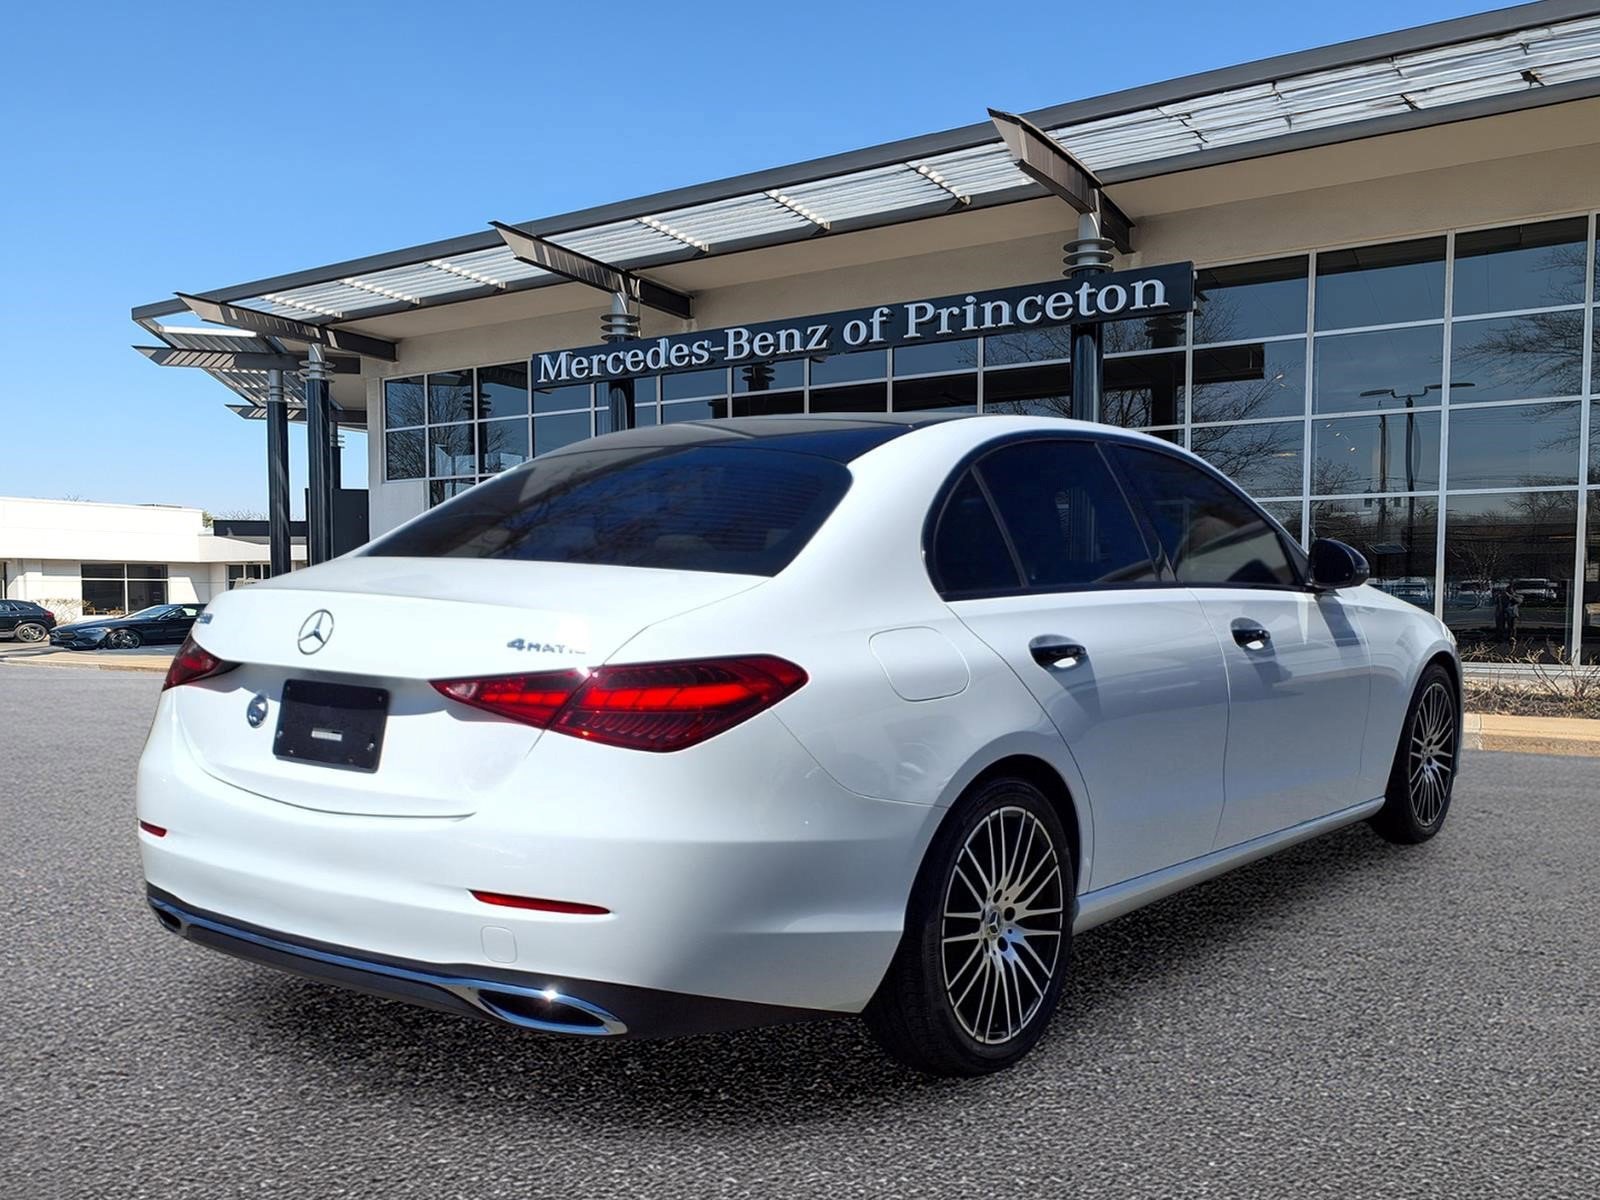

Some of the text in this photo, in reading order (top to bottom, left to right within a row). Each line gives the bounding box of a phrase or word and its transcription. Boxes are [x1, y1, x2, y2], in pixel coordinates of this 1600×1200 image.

[537, 278, 1170, 383] Mercedes-Benz of Princeton
